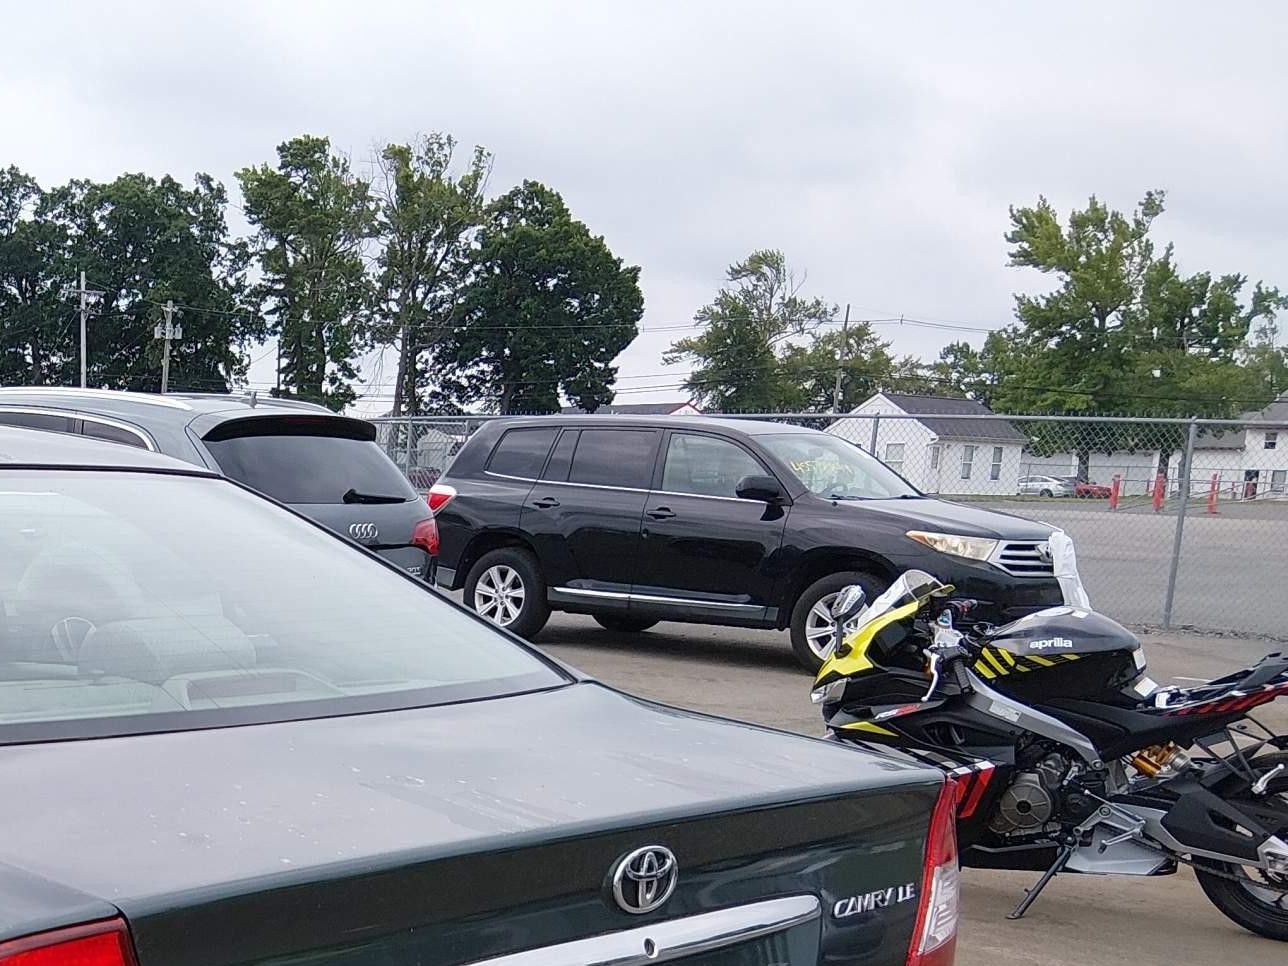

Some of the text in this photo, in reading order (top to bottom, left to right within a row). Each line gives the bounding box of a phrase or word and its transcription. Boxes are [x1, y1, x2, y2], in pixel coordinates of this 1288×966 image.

[1029, 637, 1073, 650] aprilia
[834, 882, 916, 919] CAMRY LE
